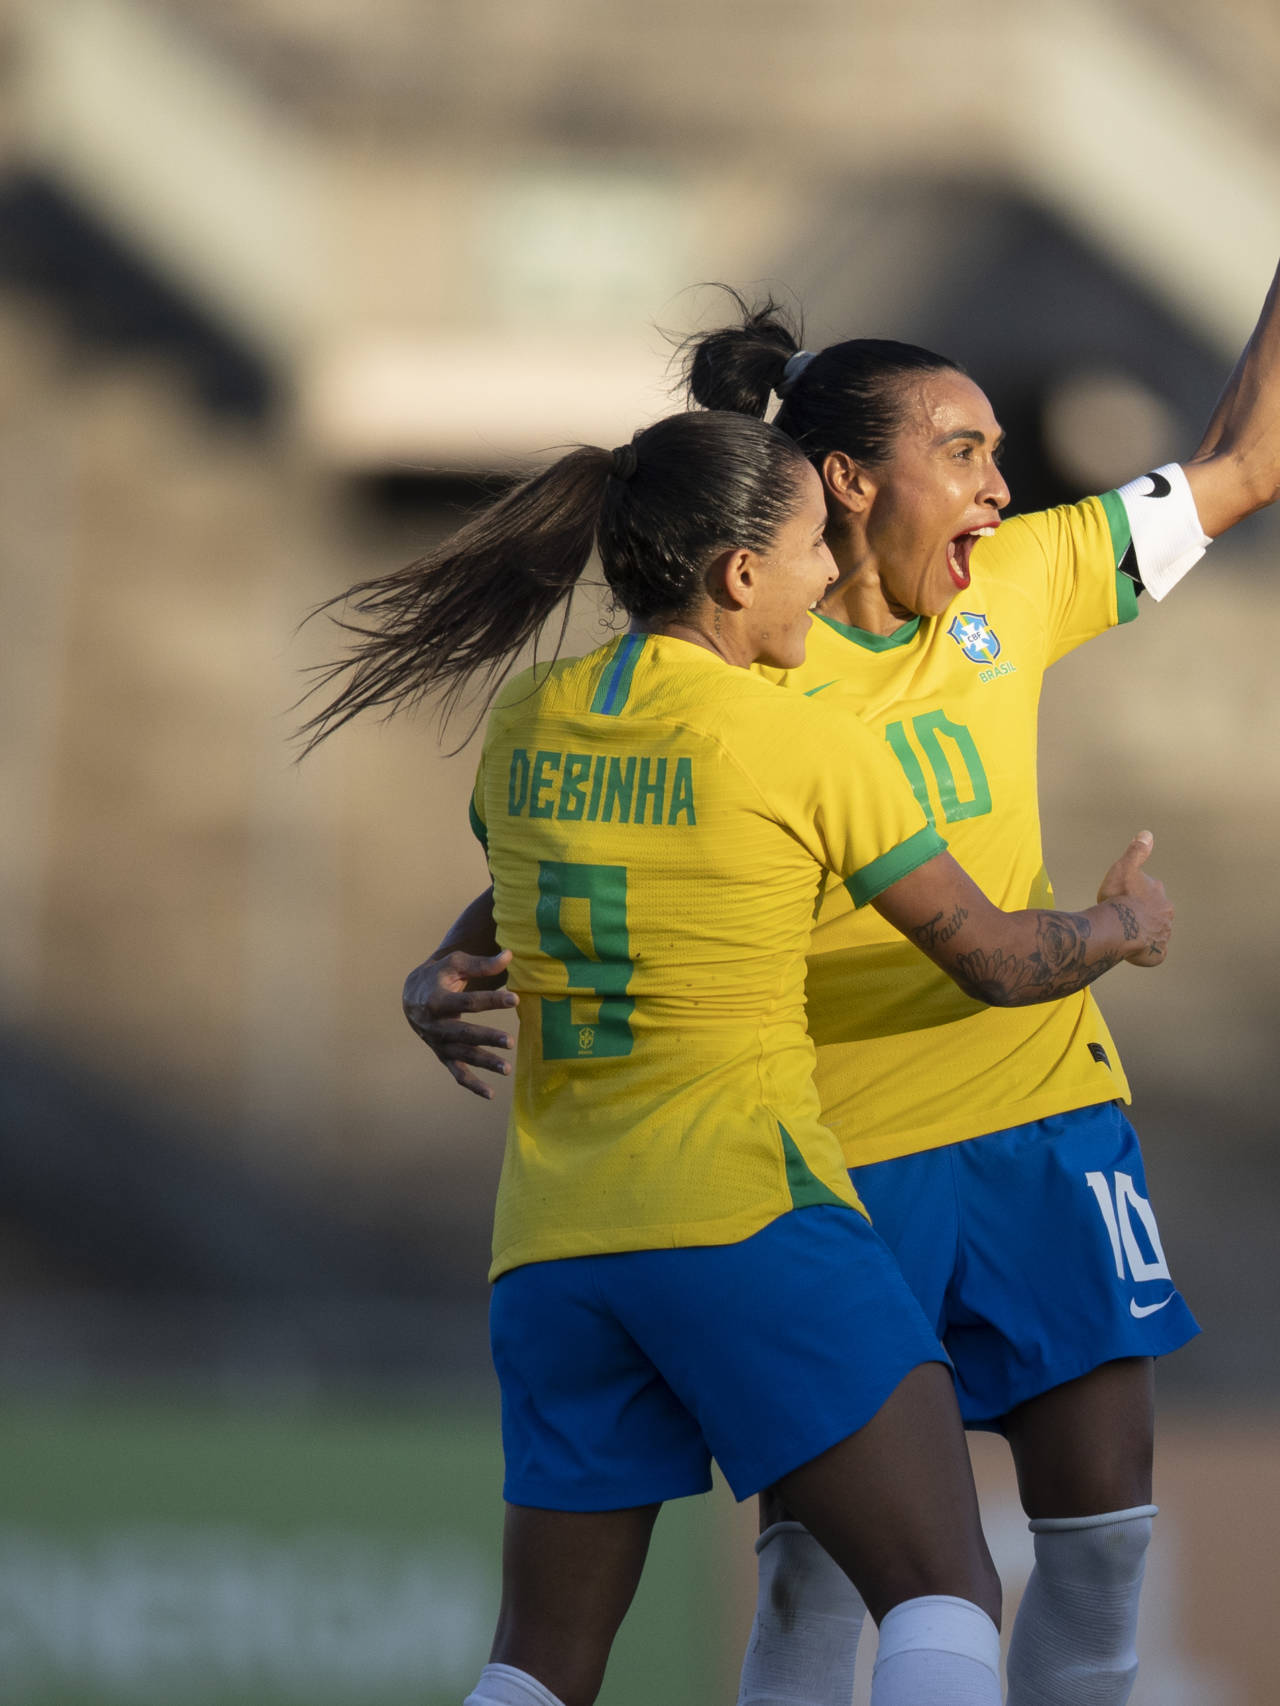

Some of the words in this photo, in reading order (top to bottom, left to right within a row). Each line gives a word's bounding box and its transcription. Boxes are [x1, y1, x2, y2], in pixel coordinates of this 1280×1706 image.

[967, 631, 982, 643] CBF
[979, 661, 1017, 684] BRASIL
[508, 748, 697, 826] DEBINHA
[885, 708, 993, 829] 10
[536, 859, 635, 1061] 9
[911, 904, 969, 951] Faith
[1084, 1170, 1172, 1283] 10
